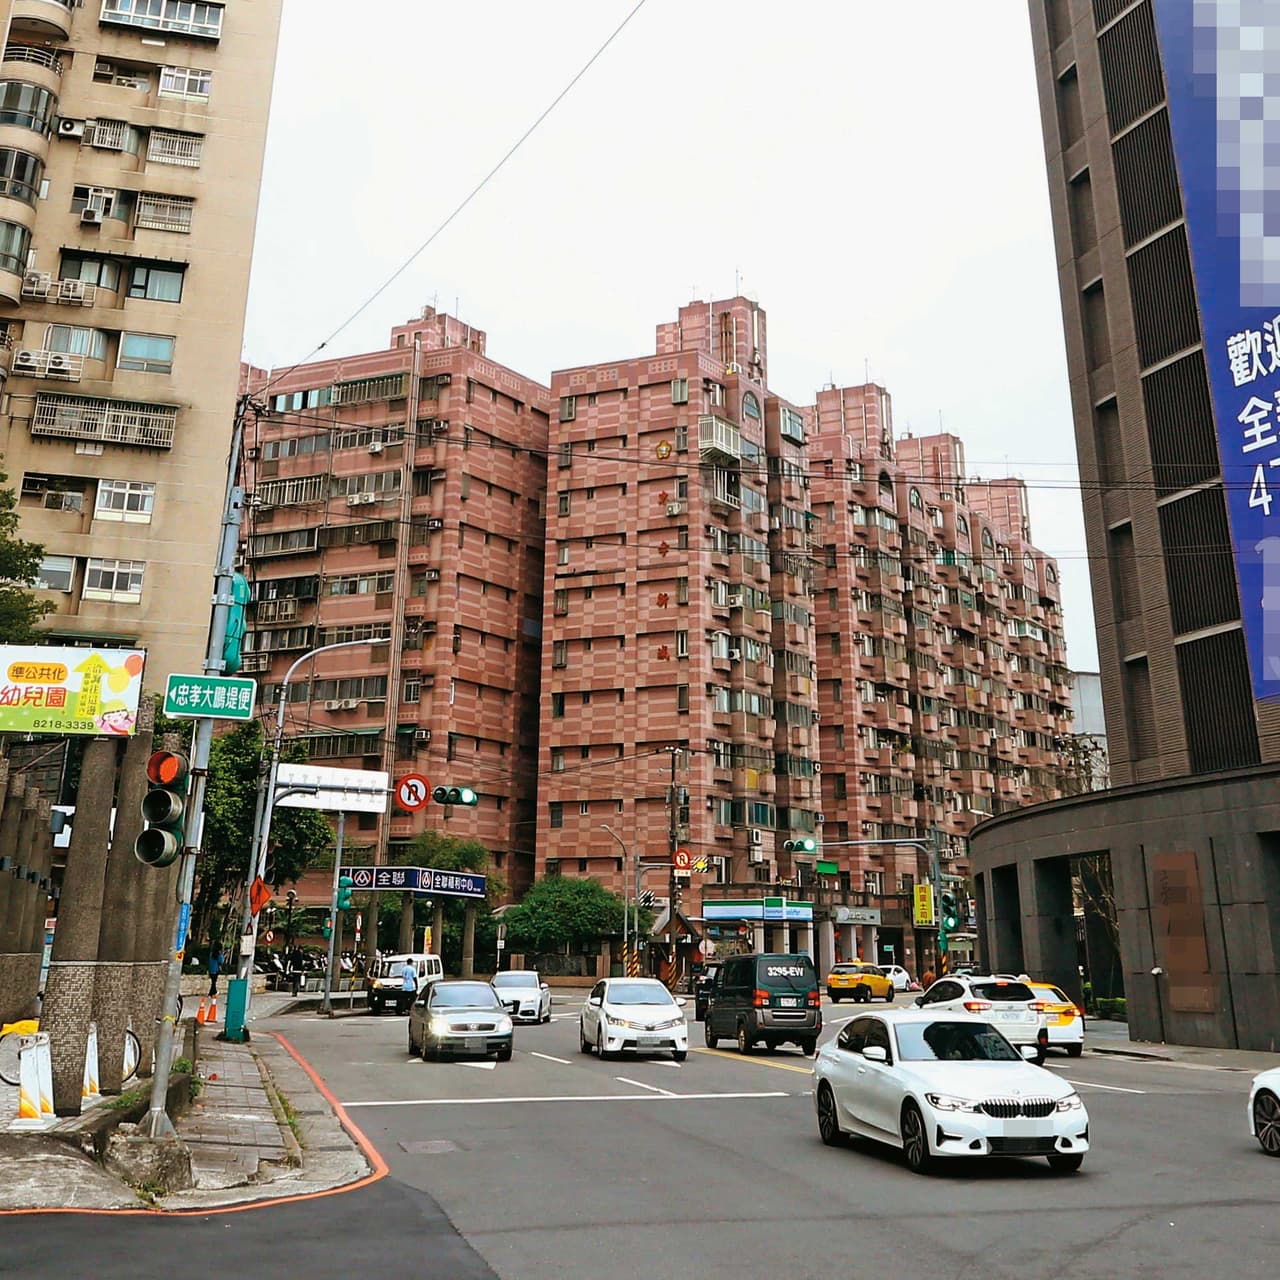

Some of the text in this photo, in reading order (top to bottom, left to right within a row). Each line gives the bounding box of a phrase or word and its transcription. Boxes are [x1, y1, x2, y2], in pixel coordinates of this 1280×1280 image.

[12, 665, 66, 681] 準公共化
[176, 683, 252, 711] 忠孝大鵬堤便
[33, 720, 94, 730] 8218-3339
[377, 871, 406, 886] 全聯
[767, 966, 804, 977] 3295-EW
